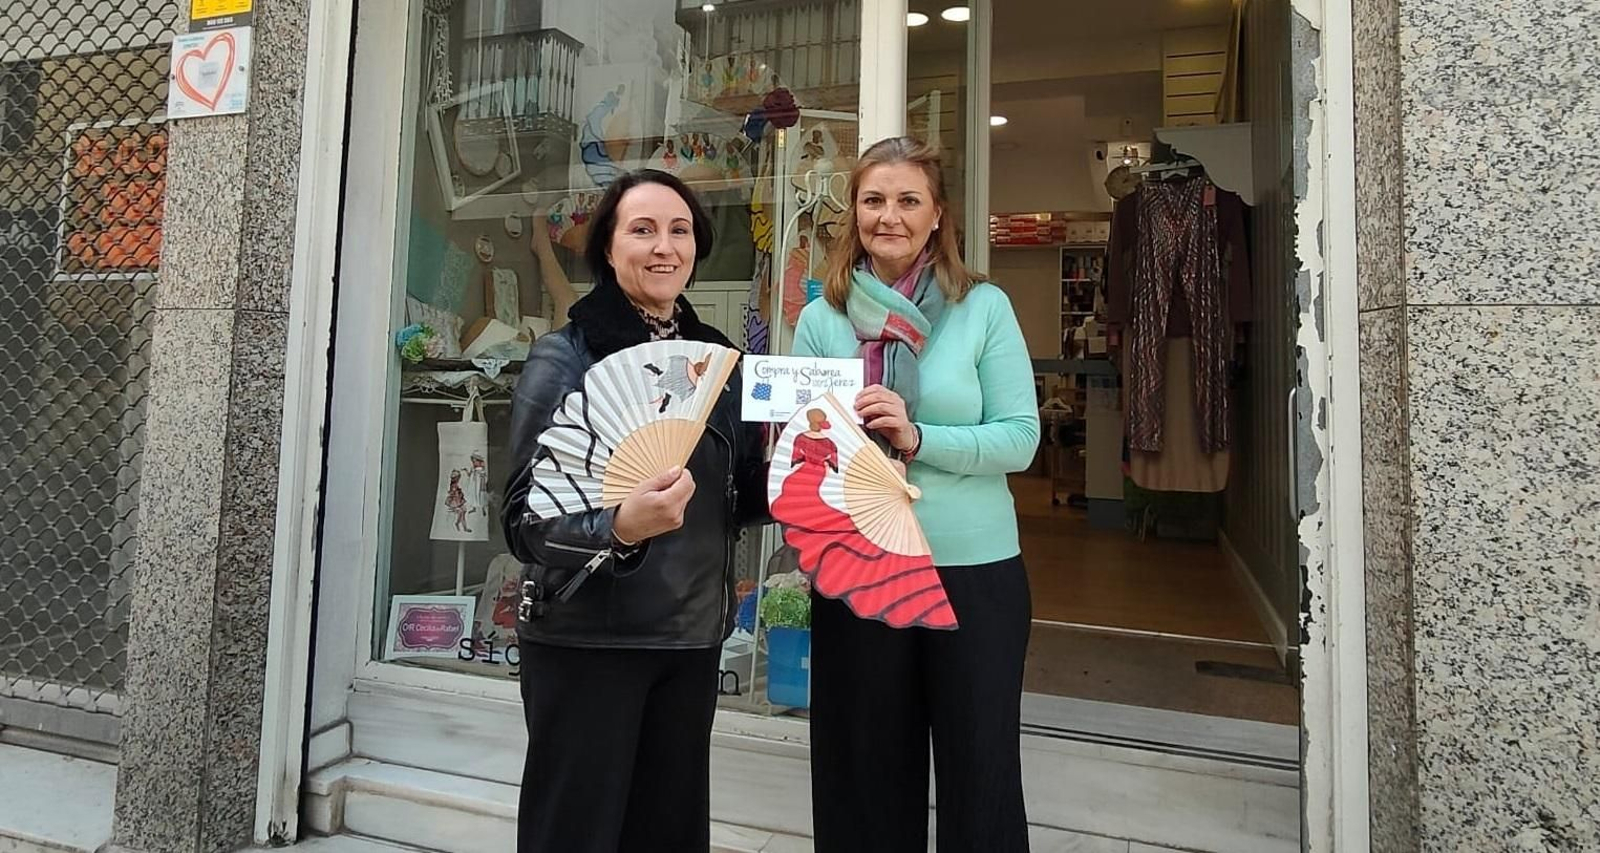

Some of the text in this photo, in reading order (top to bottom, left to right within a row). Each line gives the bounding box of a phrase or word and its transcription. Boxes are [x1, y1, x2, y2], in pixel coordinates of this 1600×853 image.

[754, 360, 842, 386] Compra y Saborea
